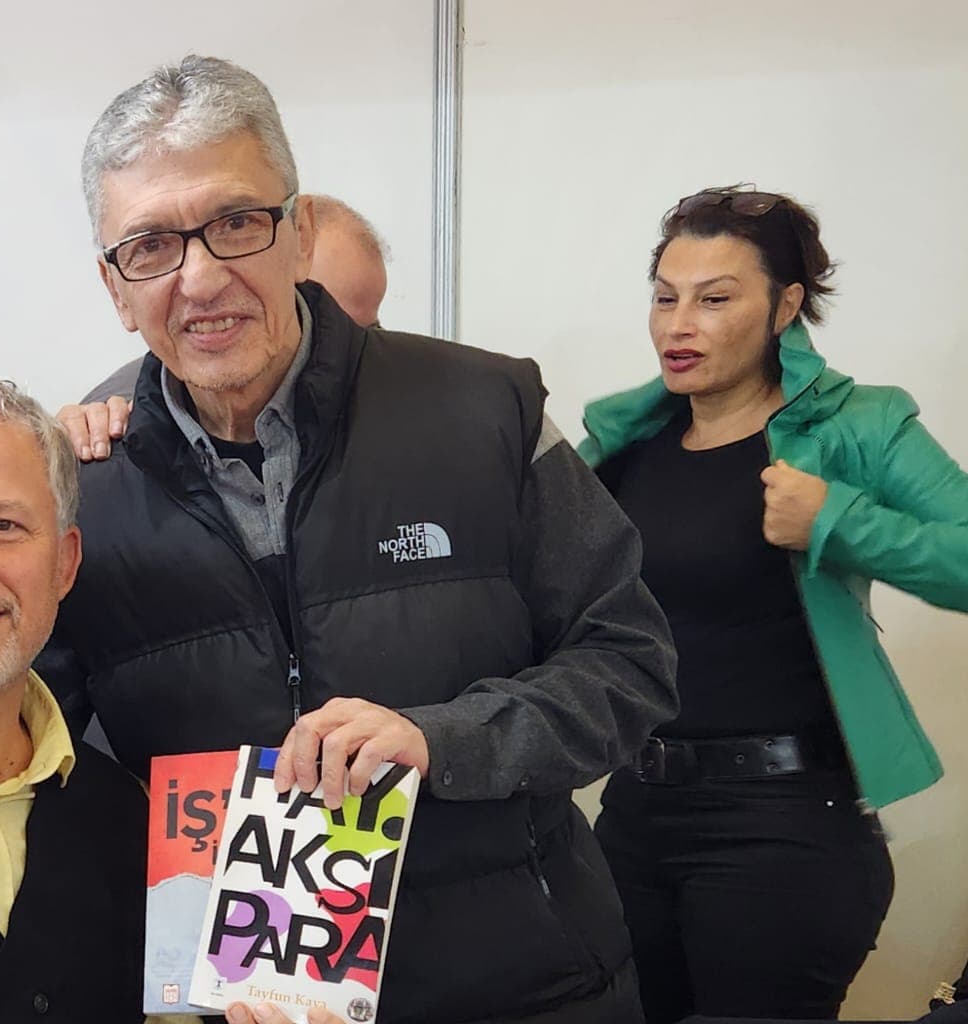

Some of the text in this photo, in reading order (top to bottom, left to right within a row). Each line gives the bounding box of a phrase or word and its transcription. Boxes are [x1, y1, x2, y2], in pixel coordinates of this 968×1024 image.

[397, 523, 425, 538] THE
[378, 535, 425, 554] NORTH
[393, 547, 426, 563] FACE
[208, 889, 386, 984] PARA
[247, 984, 291, 1005] Tayfun
